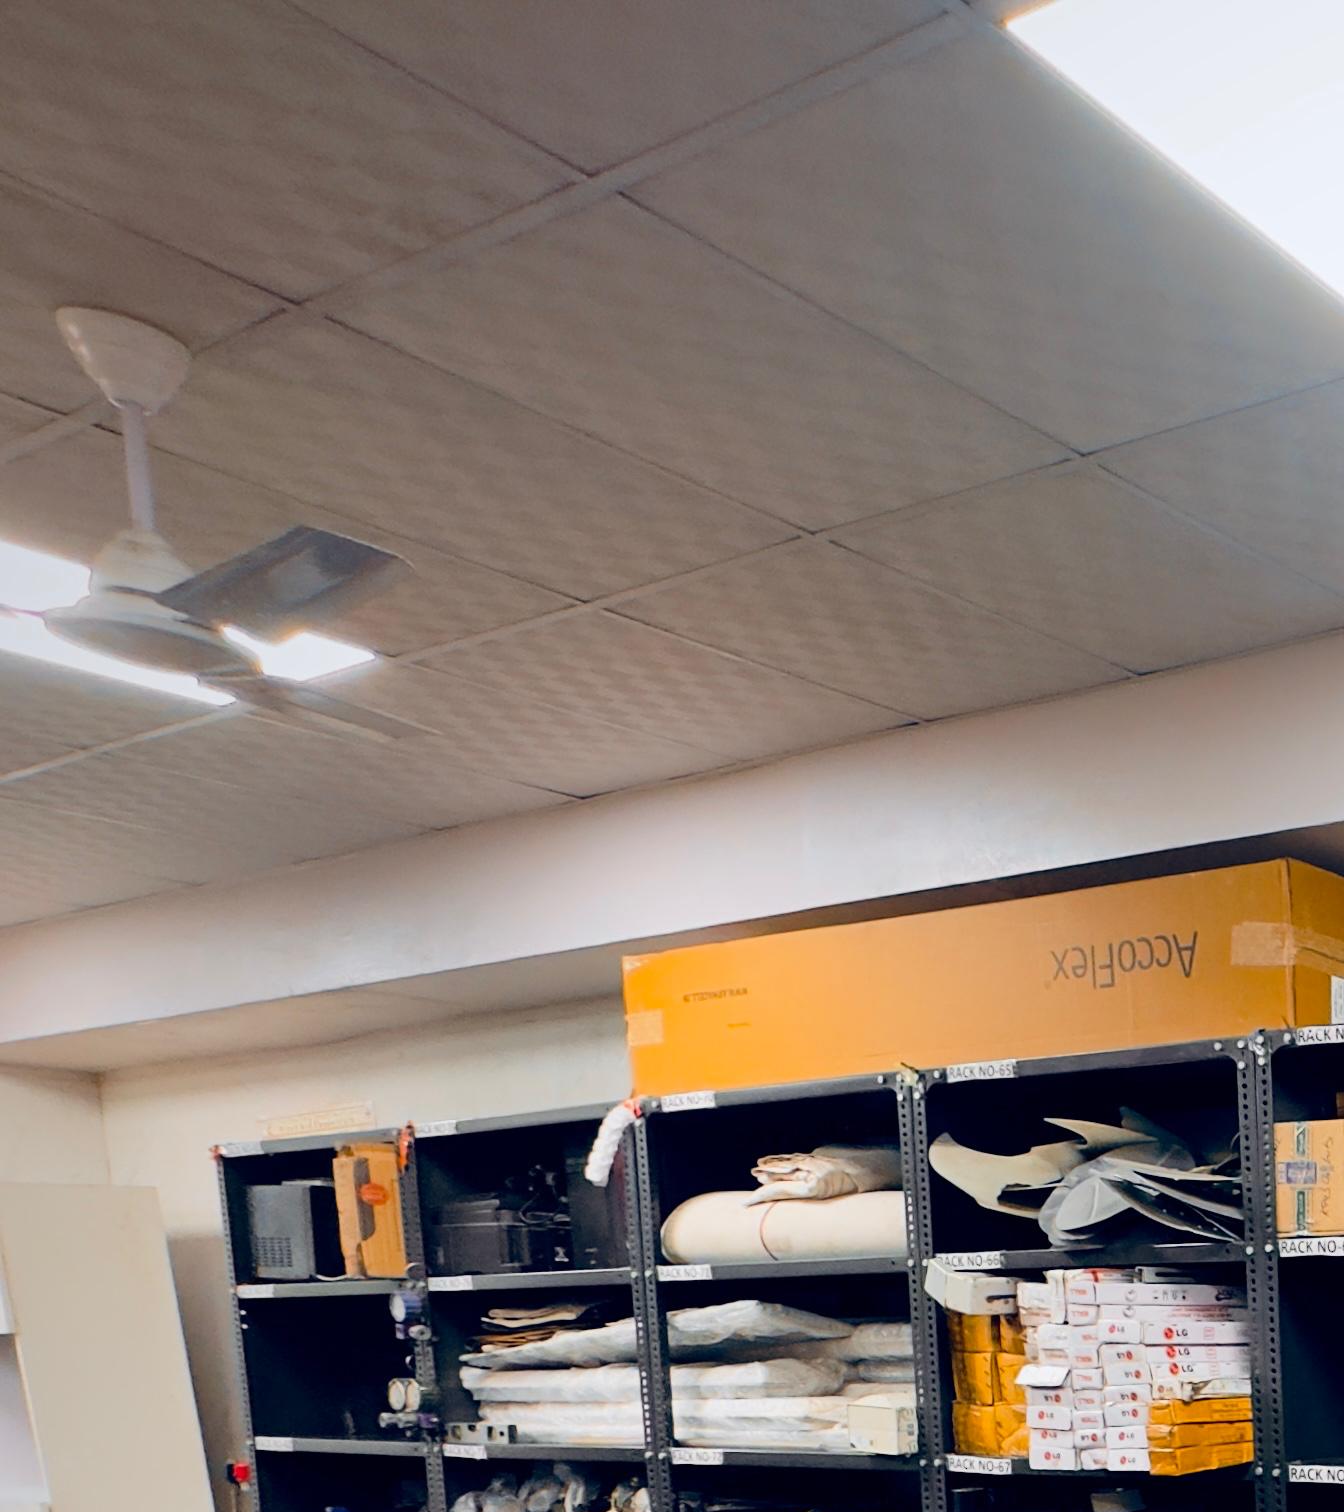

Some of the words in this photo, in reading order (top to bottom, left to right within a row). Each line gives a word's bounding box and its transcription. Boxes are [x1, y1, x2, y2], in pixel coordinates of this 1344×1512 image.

[1051, 931, 1199, 989] AccoFlex
[1298, 1029, 1332, 1043] RACK
[949, 1066, 976, 1080] RACK
[1281, 1240, 1313, 1254] RACK
[1176, 1328, 1189, 1337] LG
[1178, 1347, 1191, 1357] LG
[1182, 1364, 1194, 1374] LG
[949, 1458, 975, 1470] RACK
[978, 1460, 1011, 1473] NO-67
[1290, 1468, 1323, 1481] RACK
